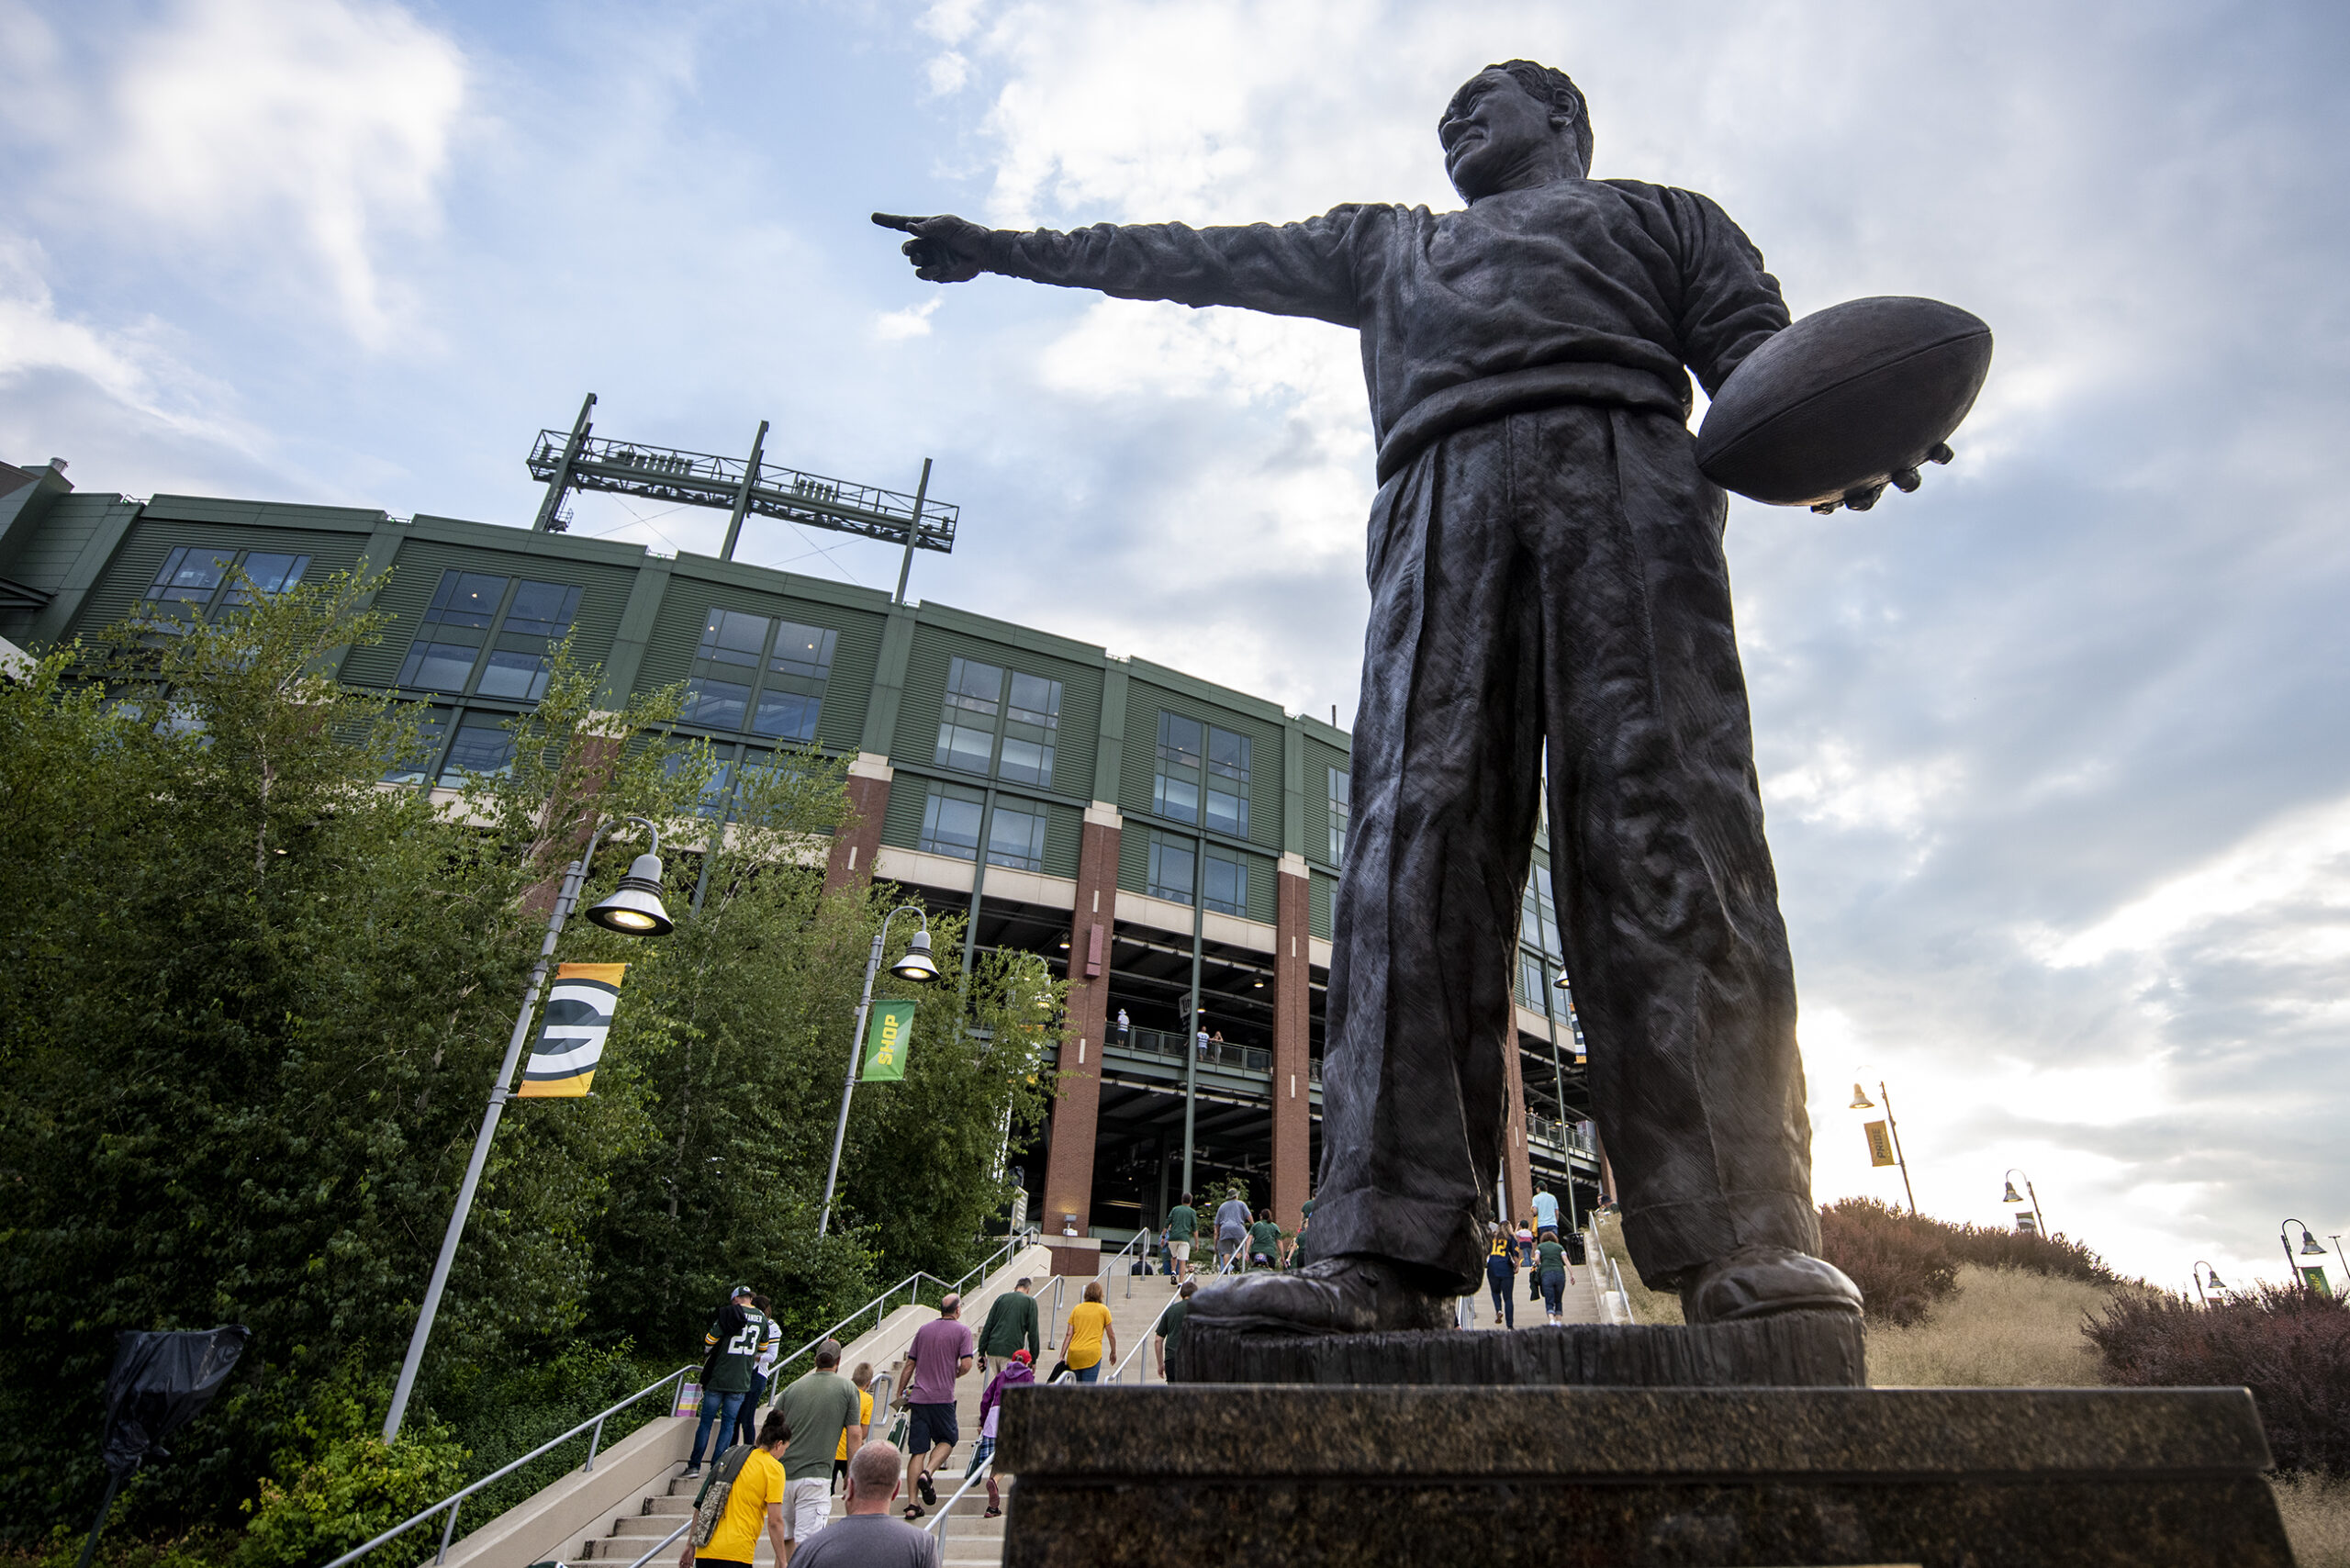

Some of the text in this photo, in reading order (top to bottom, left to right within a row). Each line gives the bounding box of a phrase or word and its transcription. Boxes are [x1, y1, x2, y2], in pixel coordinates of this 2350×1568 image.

[878, 1014, 899, 1065] SHOP
[1872, 1128, 1886, 1159] PRIDE
[1490, 1238, 1507, 1257] 12
[727, 1325, 760, 1356] 23
